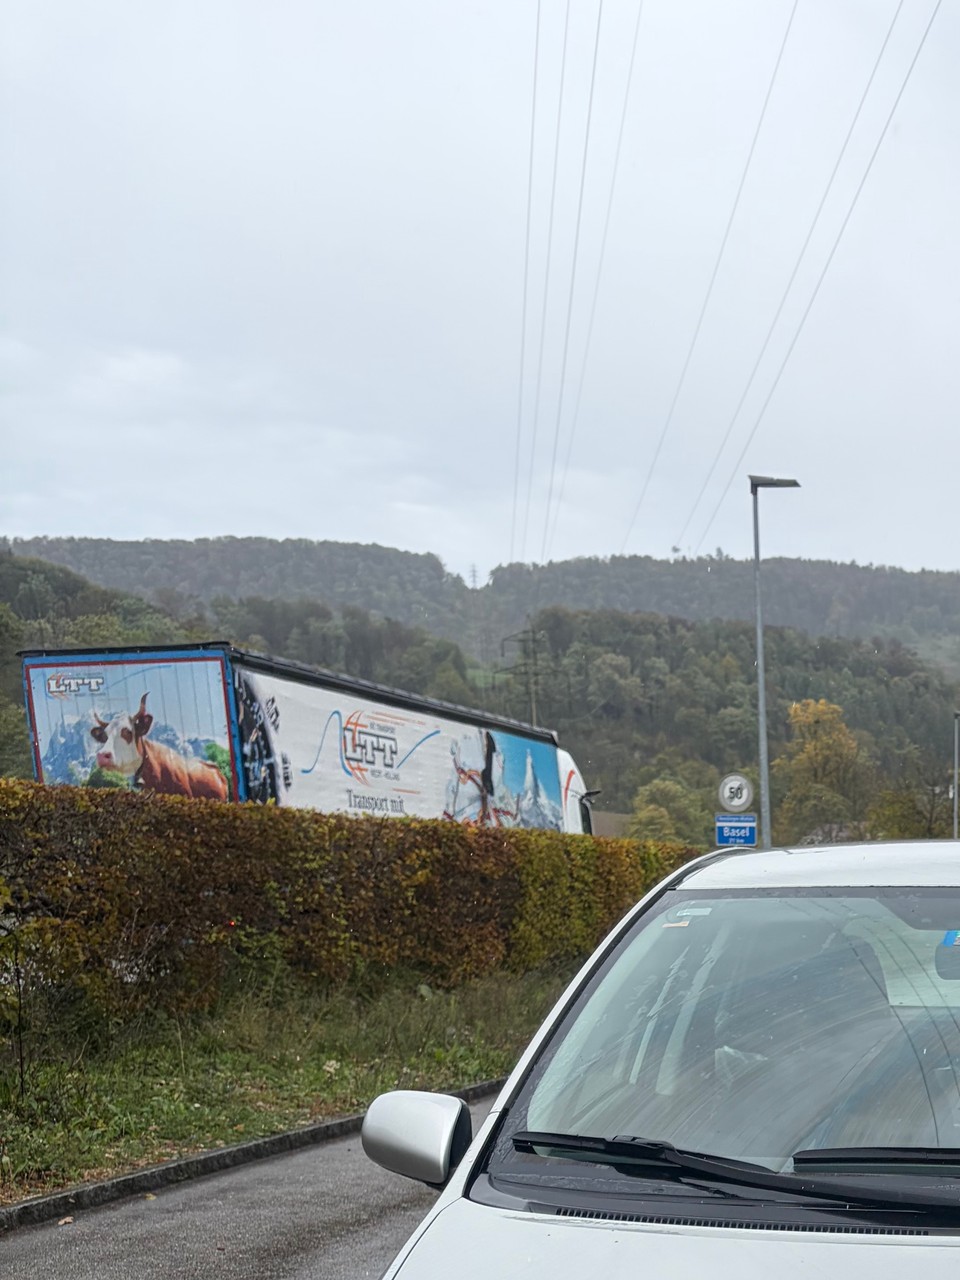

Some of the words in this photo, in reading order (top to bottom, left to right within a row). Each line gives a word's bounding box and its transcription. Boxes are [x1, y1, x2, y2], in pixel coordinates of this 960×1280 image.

[47, 677, 104, 693] LTT
[343, 727, 398, 768] LTT
[728, 786, 744, 800] 50
[346, 788, 389, 815] Transport
[723, 826, 750, 837] Basel
